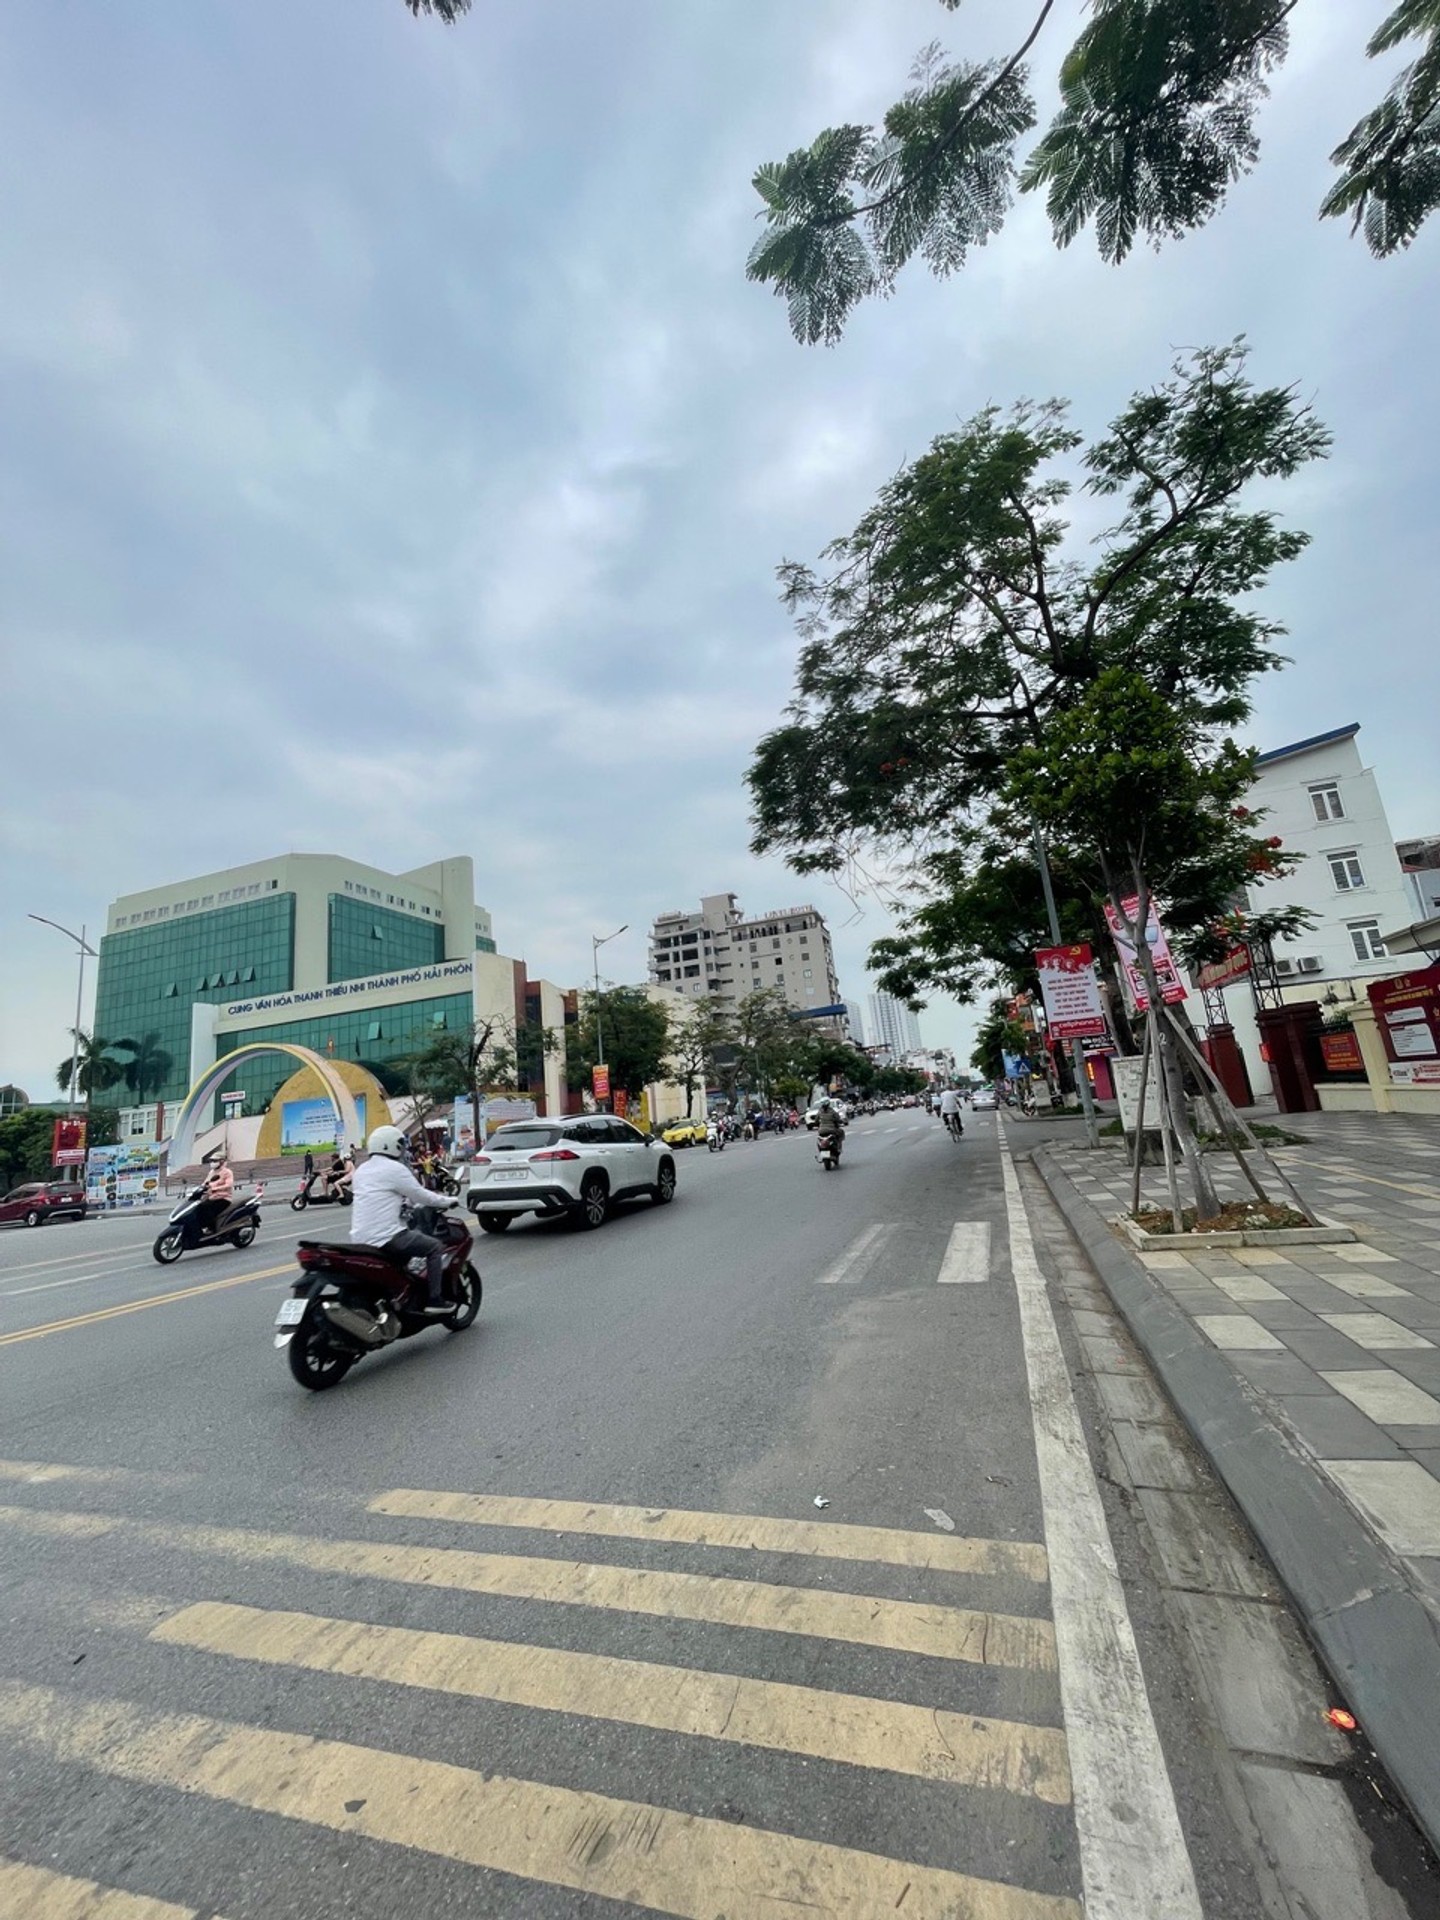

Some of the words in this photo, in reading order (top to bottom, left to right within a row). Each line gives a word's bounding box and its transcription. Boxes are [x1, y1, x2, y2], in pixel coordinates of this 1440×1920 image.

[228, 1003, 253, 1015] CUNG
[273, 995, 293, 1007] HÓA
[294, 990, 323, 1003] THANH
[325, 983, 348, 998] THIẾU
[349, 982, 366, 993] NHI
[367, 976, 399, 990] THÀNH
[401, 967, 421, 984] PHỐ
[423, 966, 441, 980] HẢI
